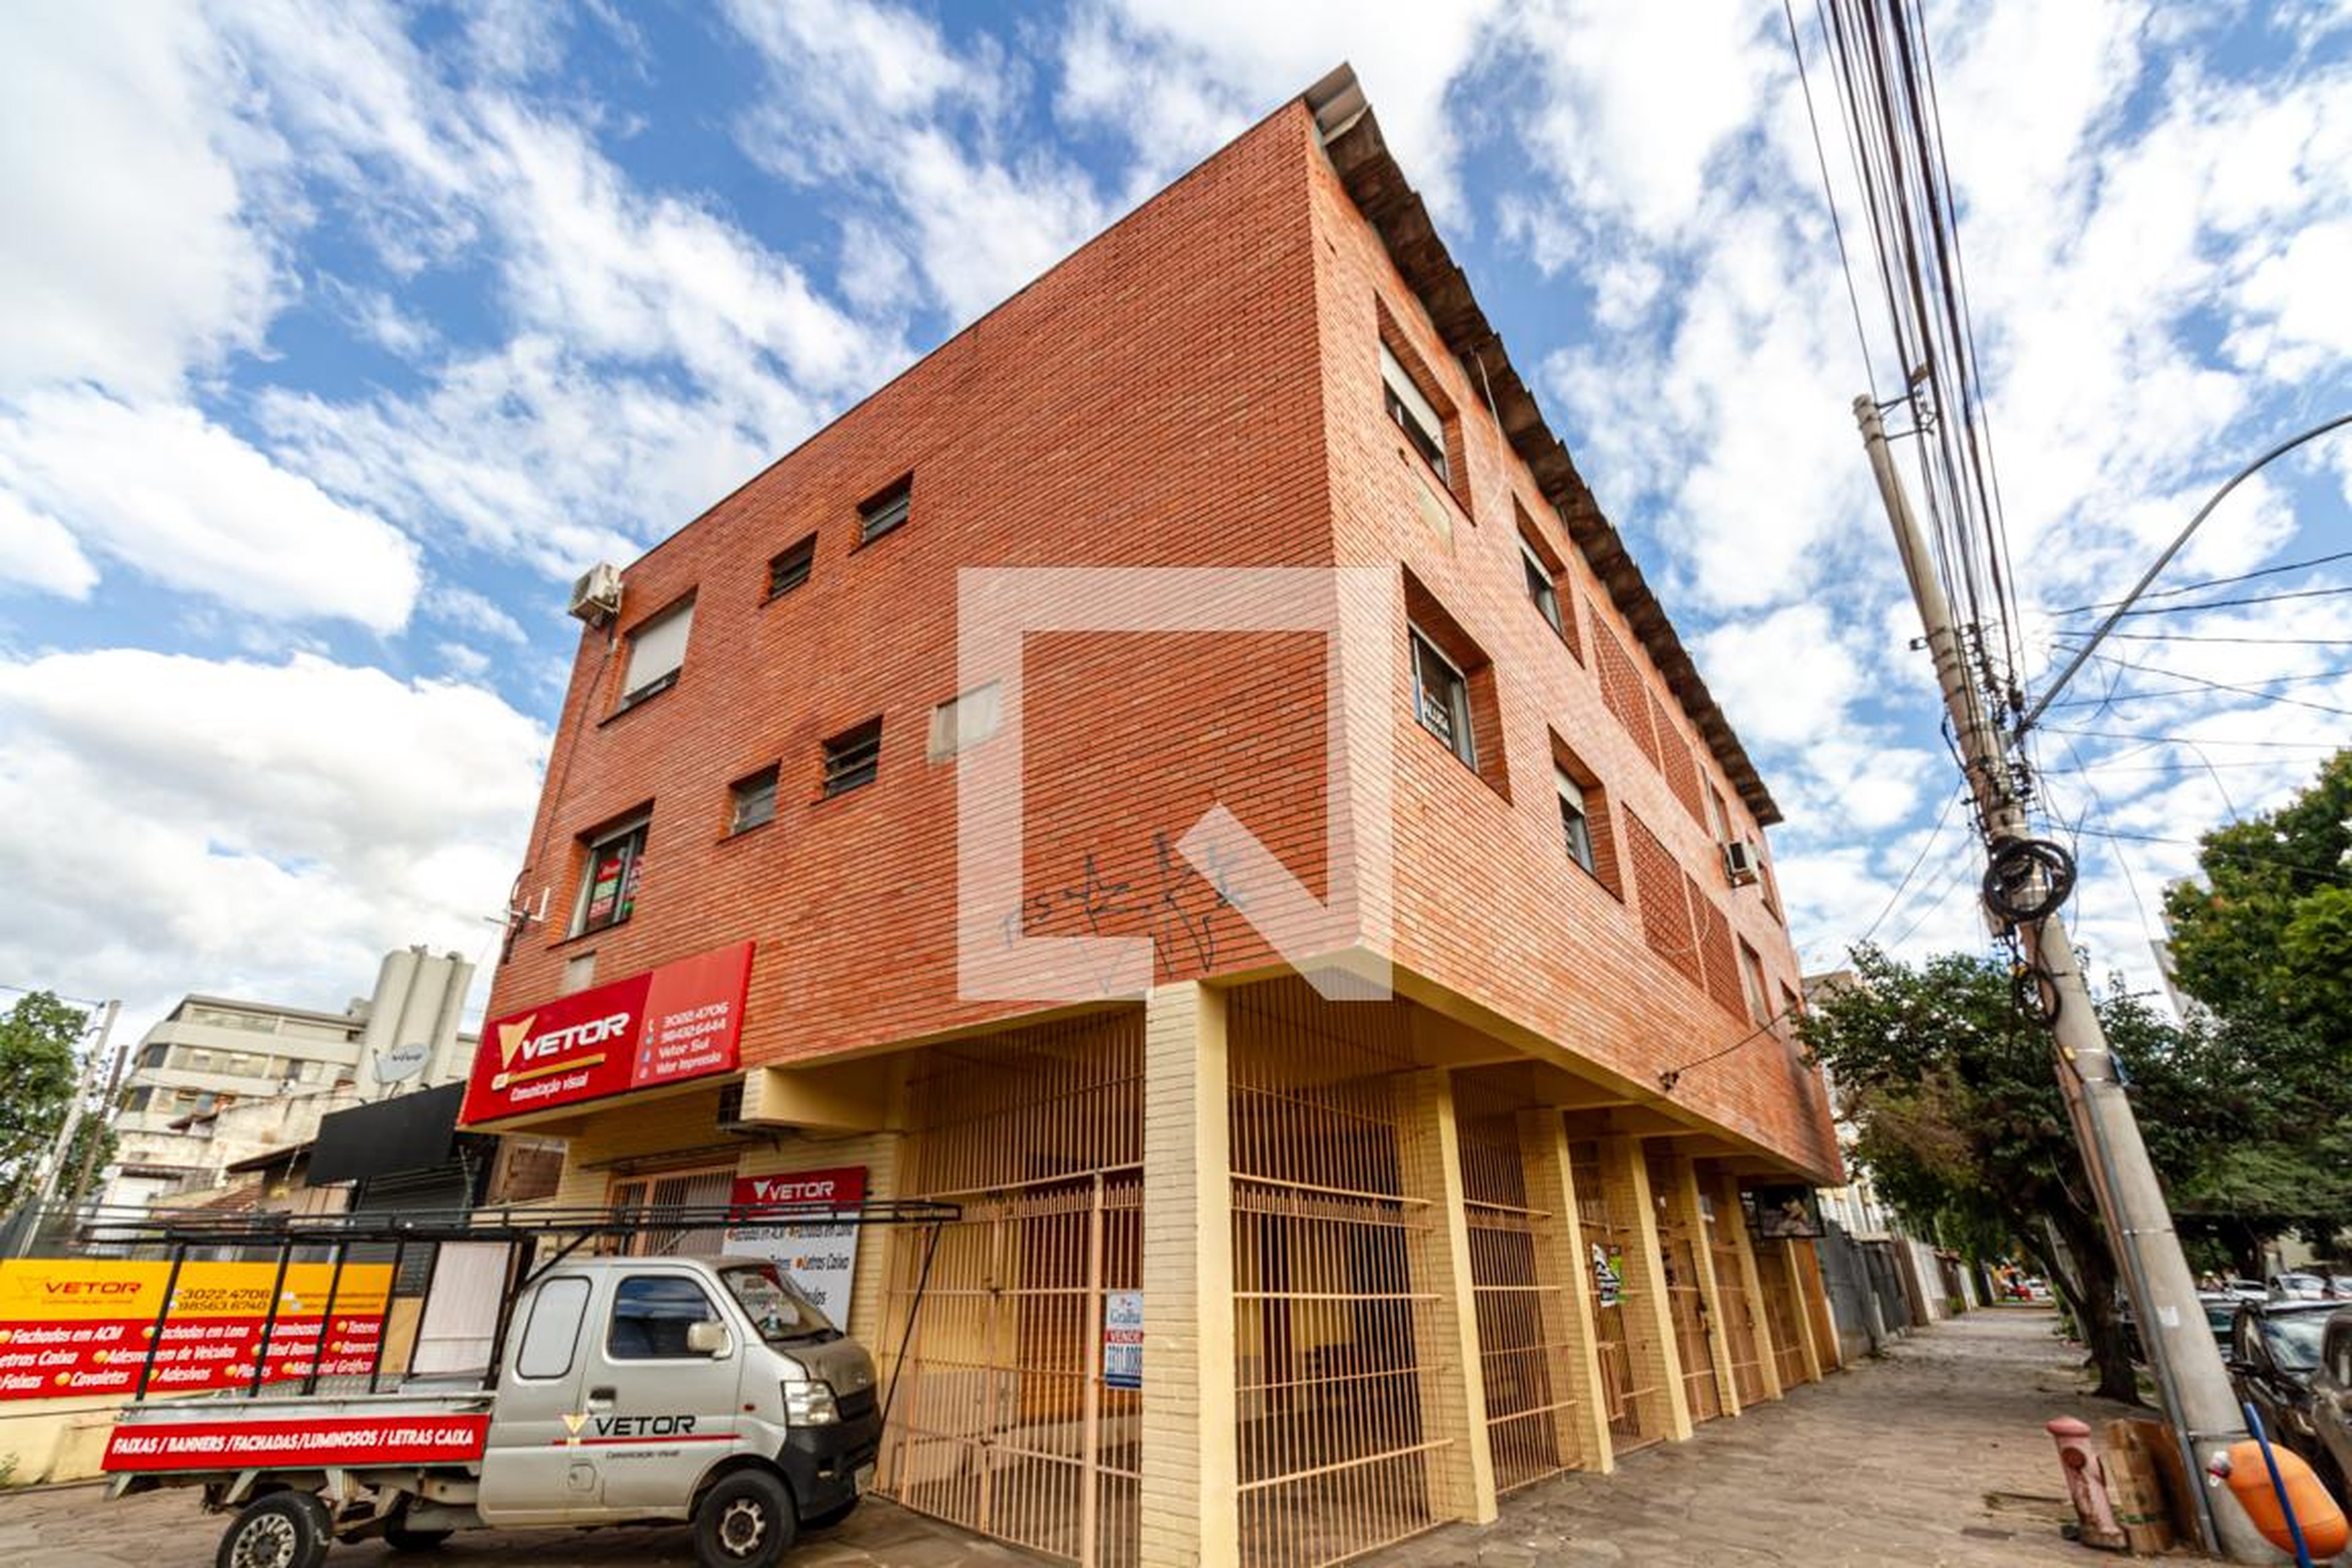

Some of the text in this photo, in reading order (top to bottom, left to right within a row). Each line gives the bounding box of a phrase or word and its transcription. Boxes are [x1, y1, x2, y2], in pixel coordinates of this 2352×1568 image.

[522, 1013, 630, 1061] VETOR
[690, 1037, 710, 1052] Sul
[769, 1181, 835, 1201] VETOR
[46, 1282, 141, 1294] VETOR
[10, 1327, 72, 1344] Fachadas
[72, 1330, 92, 1342] em
[160, 1325, 206, 1340] achadas
[0, 1349, 79, 1368] etras Caixa
[0, 1371, 44, 1390] Faixas
[70, 1368, 130, 1387] Cavaletes
[595, 1415, 696, 1436] VETOR
[112, 1438, 158, 1454] FAIXAS
[167, 1436, 225, 1453] BANNERS
[387, 1429, 433, 1446] LETRAS
[435, 1428, 475, 1446] CAIXA
